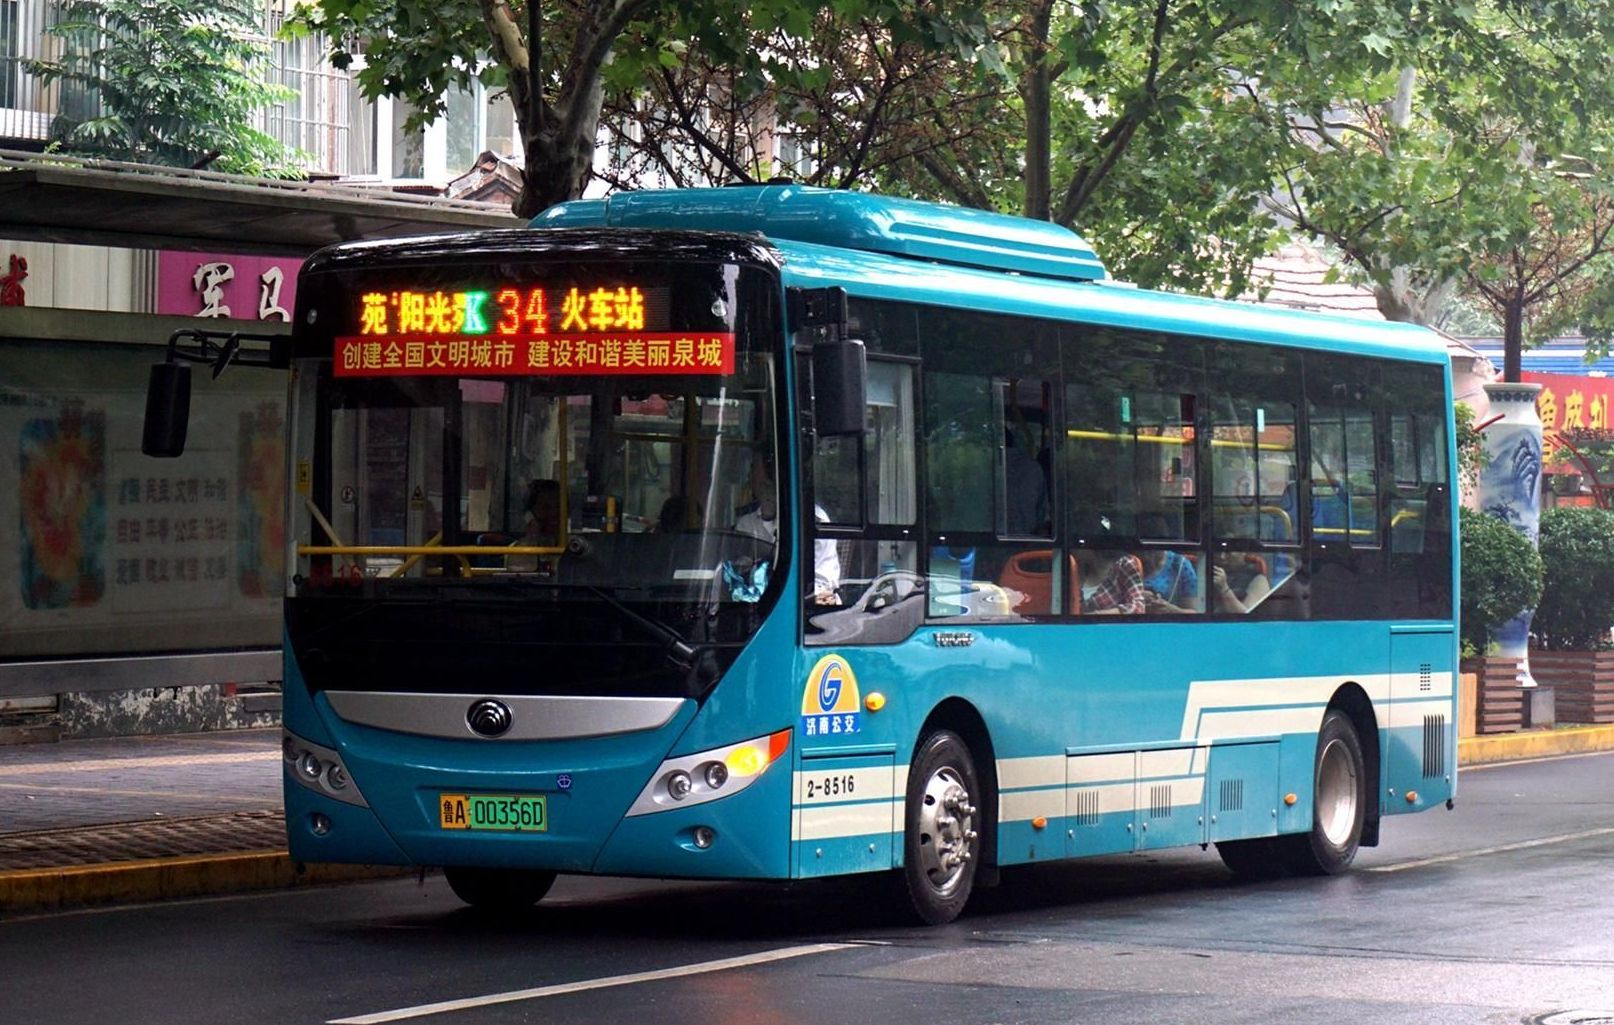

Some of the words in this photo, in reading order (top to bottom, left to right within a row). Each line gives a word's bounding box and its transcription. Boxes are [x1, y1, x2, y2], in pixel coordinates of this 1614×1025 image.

[499, 289, 547, 334] 34
[561, 287, 644, 331] 火车站
[342, 340, 516, 369] 创建全国文明城市
[527, 337, 722, 367] 建设和谐美丽泉城
[806, 715, 854, 736] 济南公交
[807, 775, 854, 798] 2-8516
